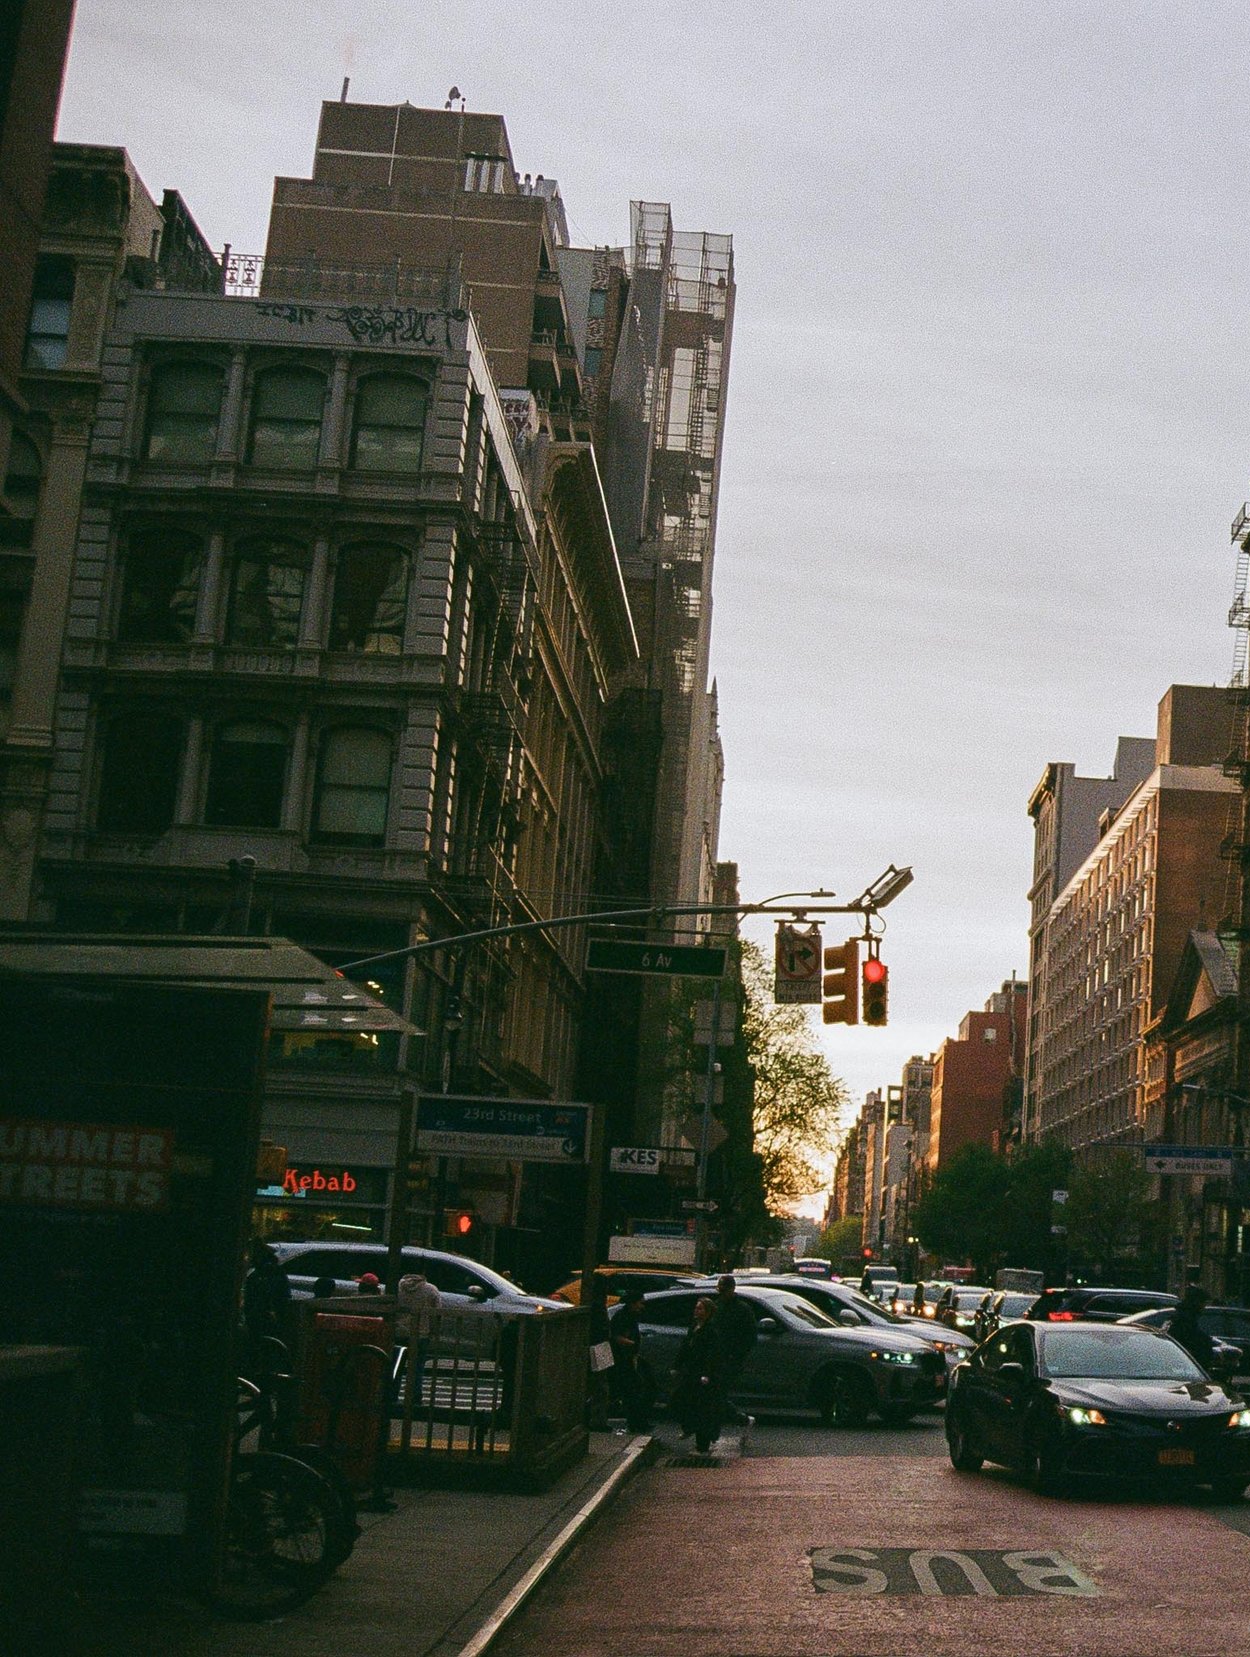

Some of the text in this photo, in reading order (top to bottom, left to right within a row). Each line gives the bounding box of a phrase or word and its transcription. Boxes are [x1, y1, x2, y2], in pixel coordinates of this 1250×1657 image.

[641, 952, 672, 969] 6 Av
[463, 1108, 542, 1123] 23rd Street
[282, 1168, 357, 1193] Kebab
[811, 1547, 1098, 1598] BUS
